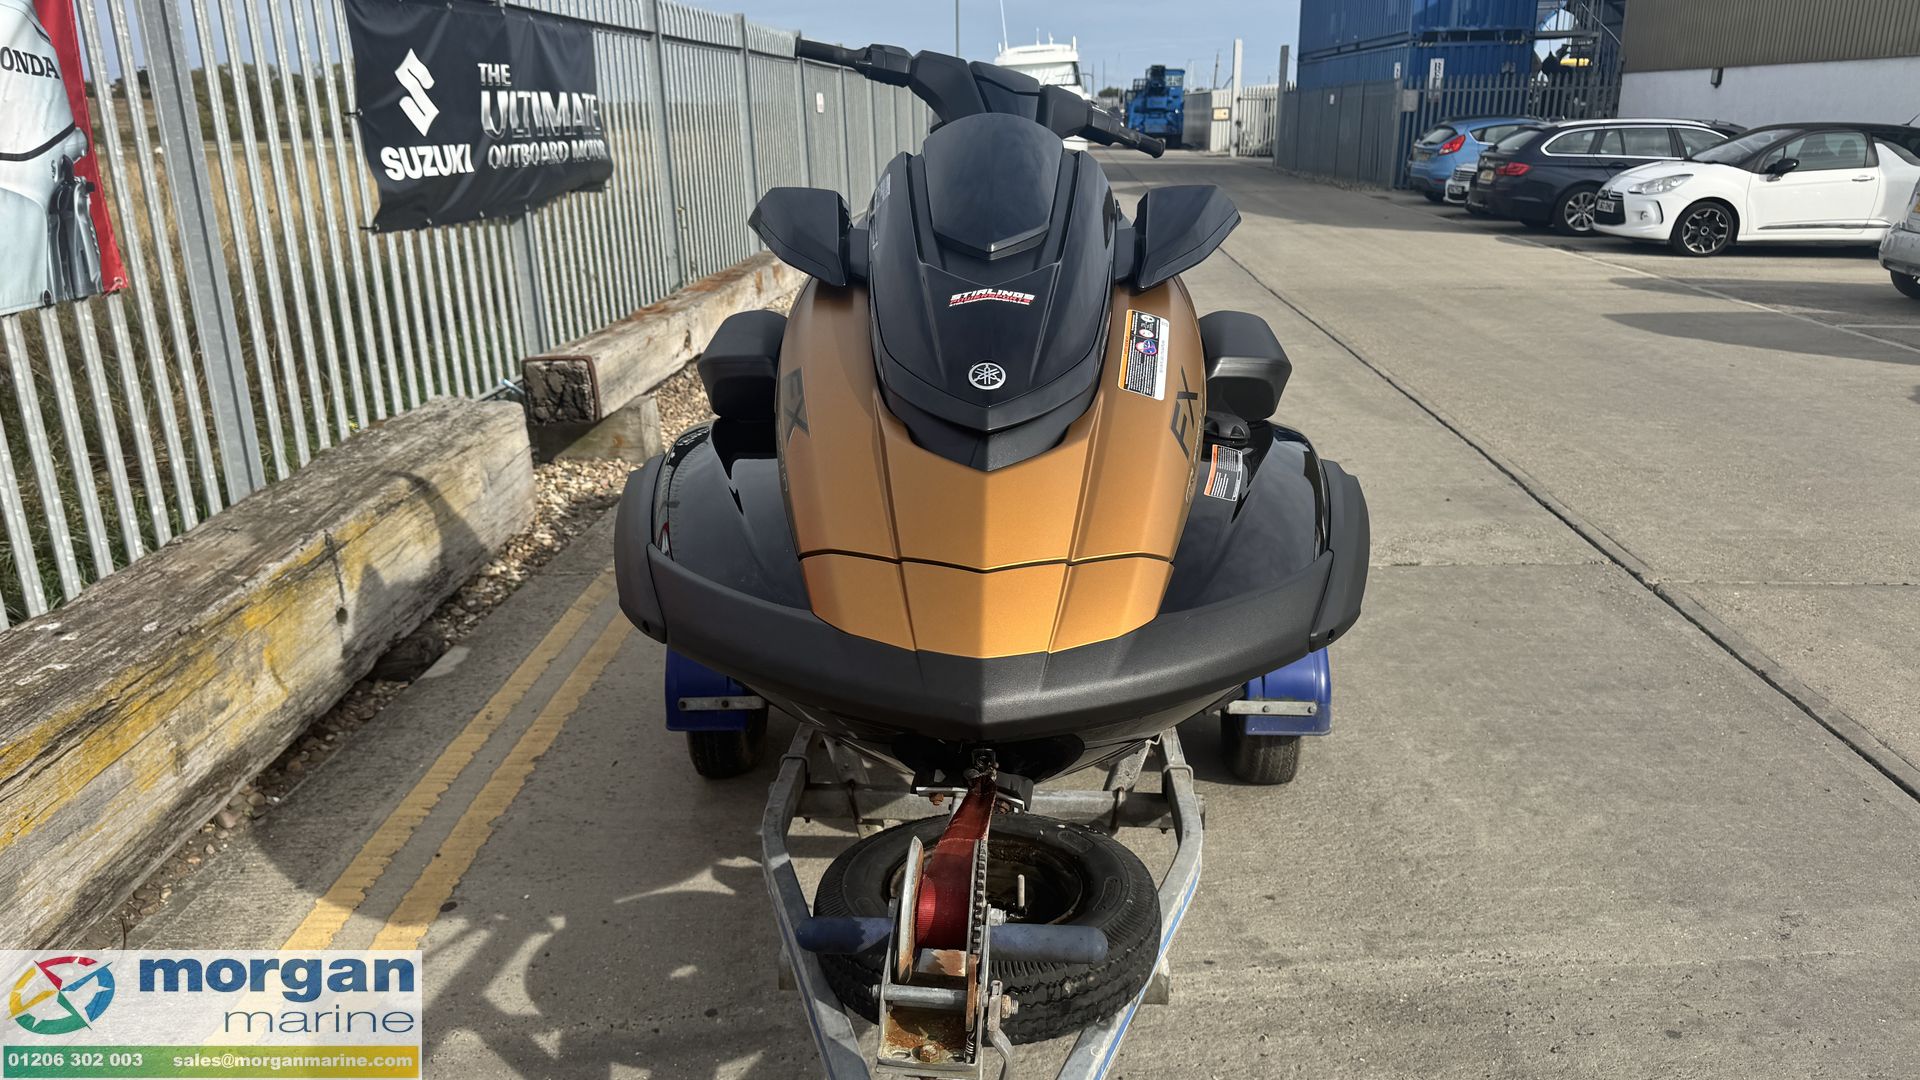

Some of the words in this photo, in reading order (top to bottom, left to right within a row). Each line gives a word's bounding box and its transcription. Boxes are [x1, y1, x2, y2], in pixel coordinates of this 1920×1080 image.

[477, 62, 512, 87] THE
[480, 90, 601, 140] ULTIMATE
[380, 143, 475, 181] SUZUKI
[488, 140, 570, 169] OUTBOARD
